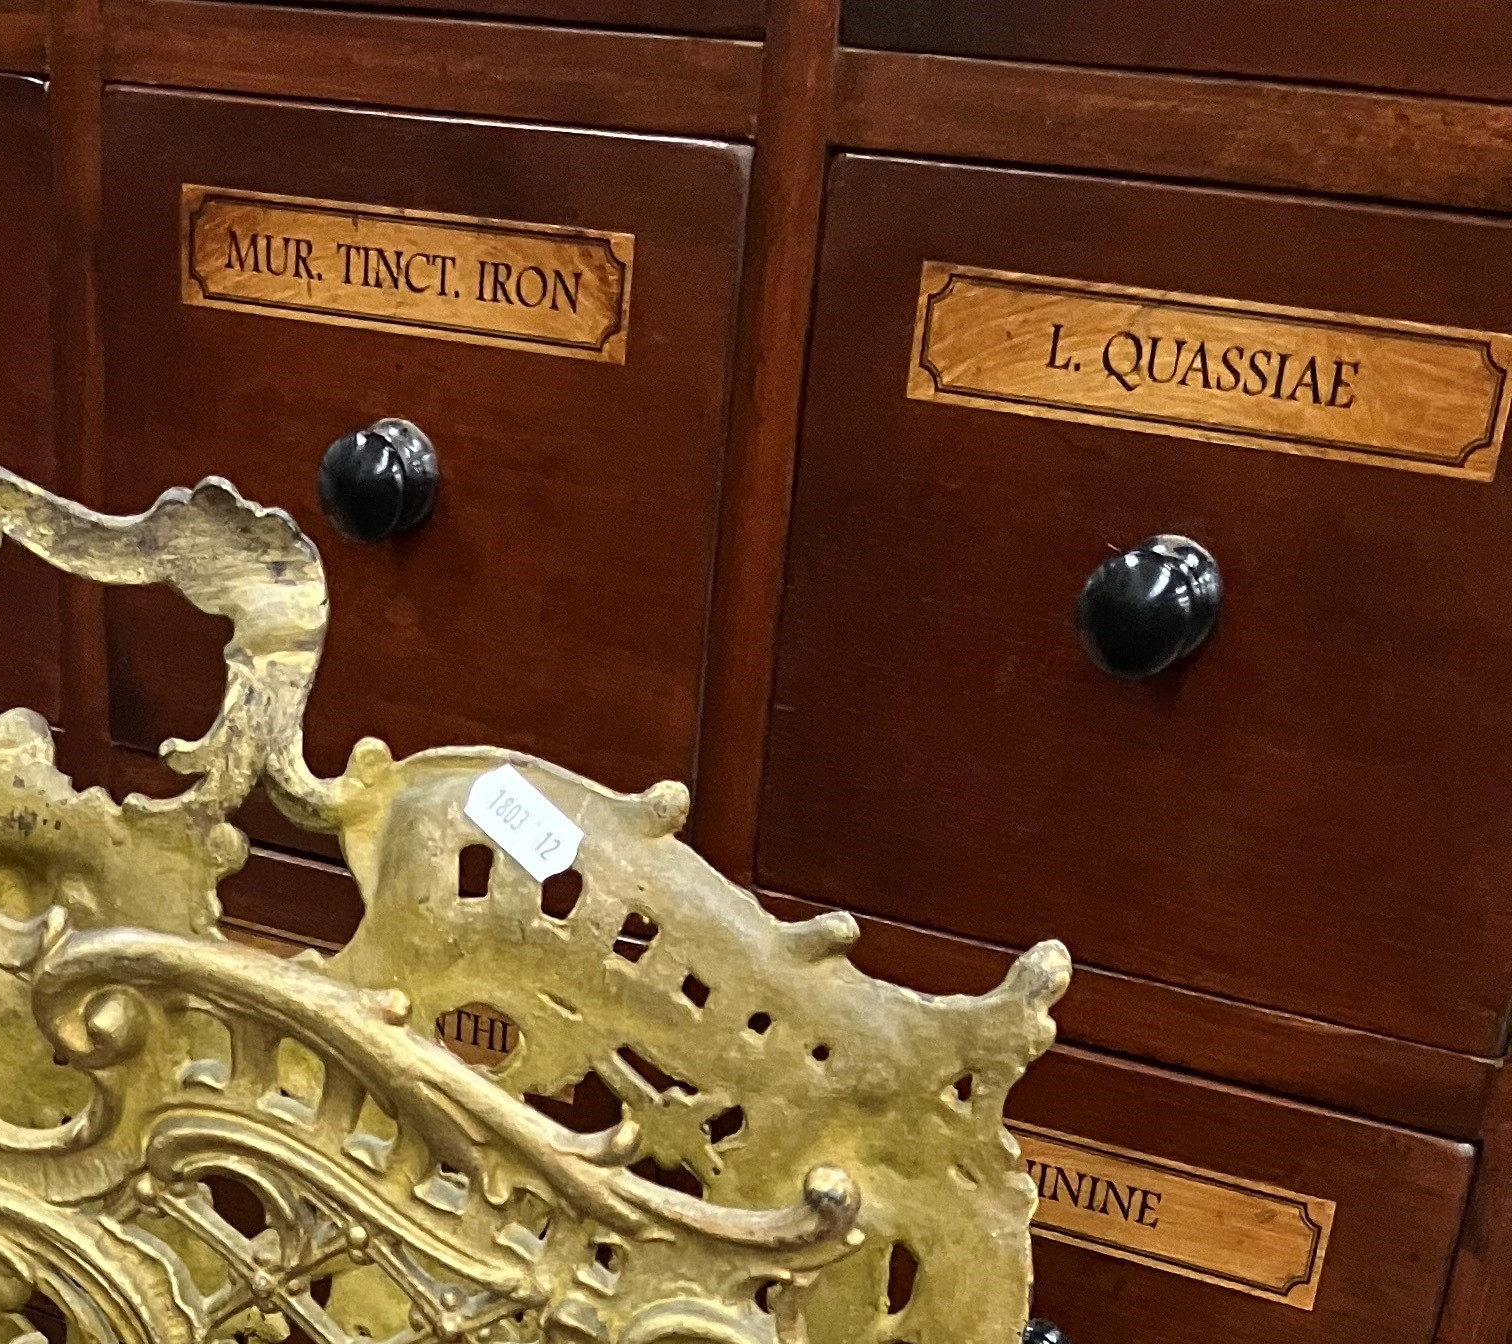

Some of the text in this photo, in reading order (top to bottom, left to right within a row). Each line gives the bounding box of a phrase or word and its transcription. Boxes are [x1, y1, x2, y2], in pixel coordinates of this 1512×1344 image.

[224, 229, 584, 314] MUR. TINCT. IRON
[1045, 323, 1361, 410] L. QUASSIAE
[489, 788, 562, 861] 1803 12
[1025, 1158, 1162, 1230] ININE
